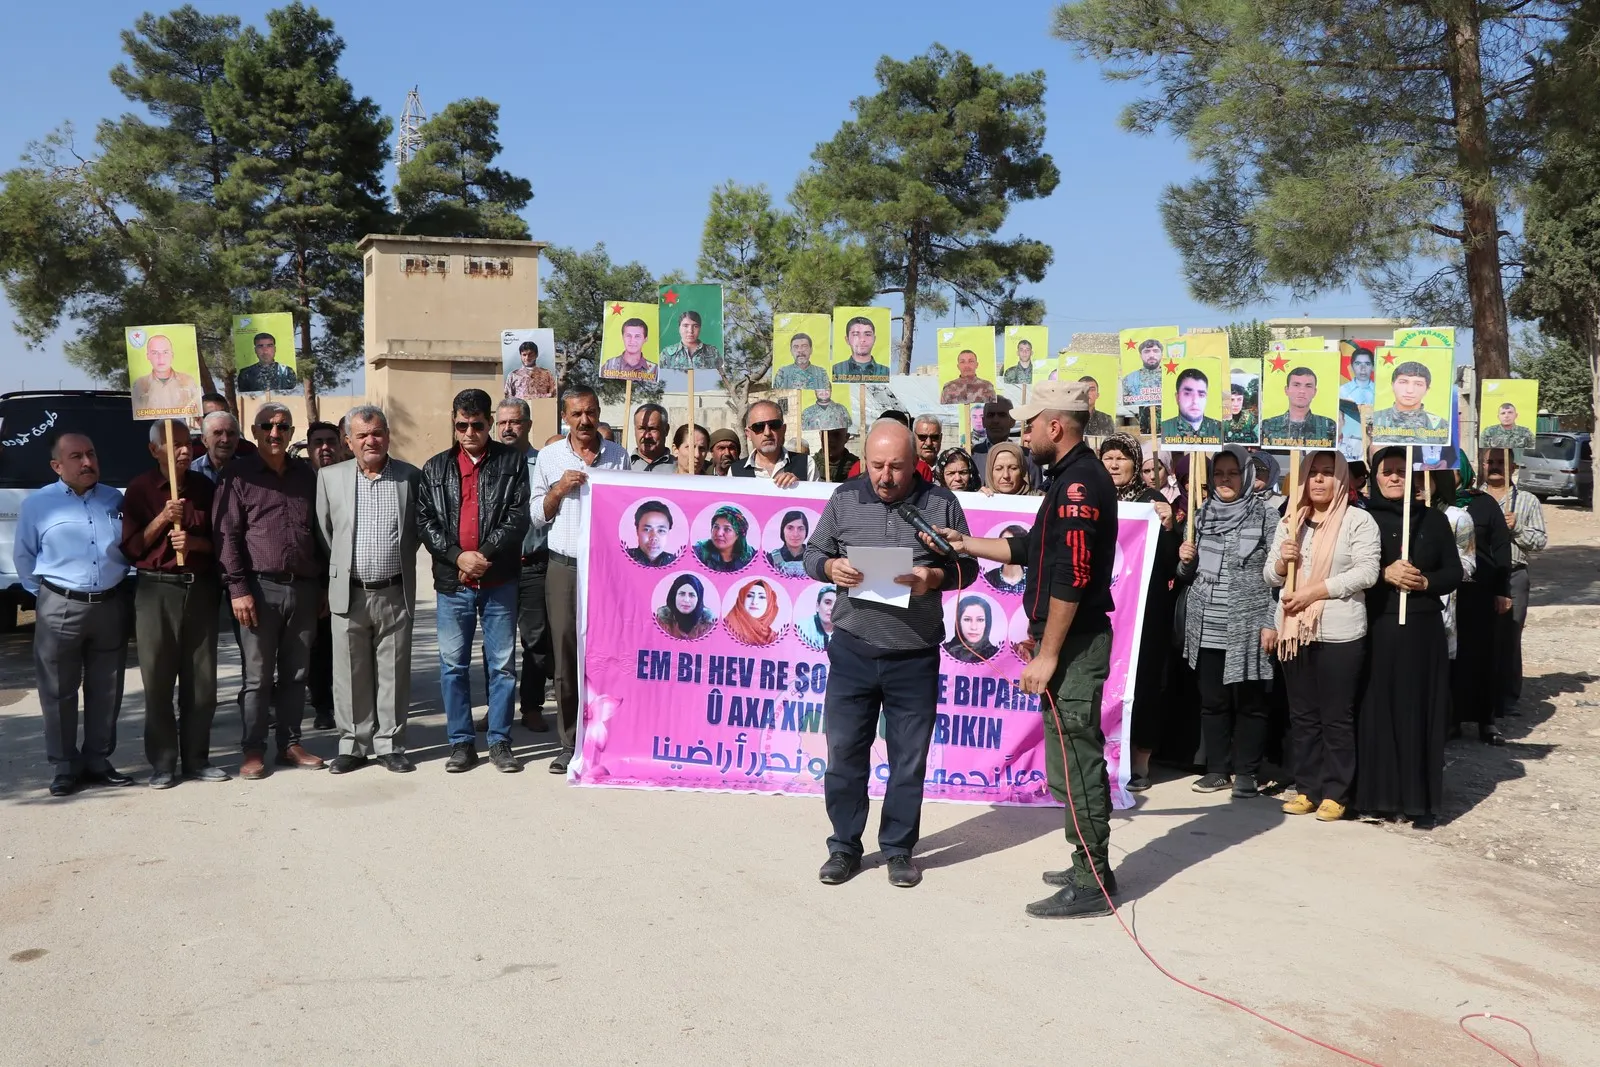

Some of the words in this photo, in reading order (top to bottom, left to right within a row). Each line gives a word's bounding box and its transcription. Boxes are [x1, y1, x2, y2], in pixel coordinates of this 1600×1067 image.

[637, 650, 671, 681] EM
[677, 652, 702, 683] BI
[708, 655, 755, 688] HEV
[760, 659, 789, 691] RE
[707, 688, 723, 725] Û
[728, 695, 776, 729] AXA
[935, 713, 1003, 750] BIKIN
[653, 732, 748, 774] أراضينا
[744, 748, 803, 777] نحرر
